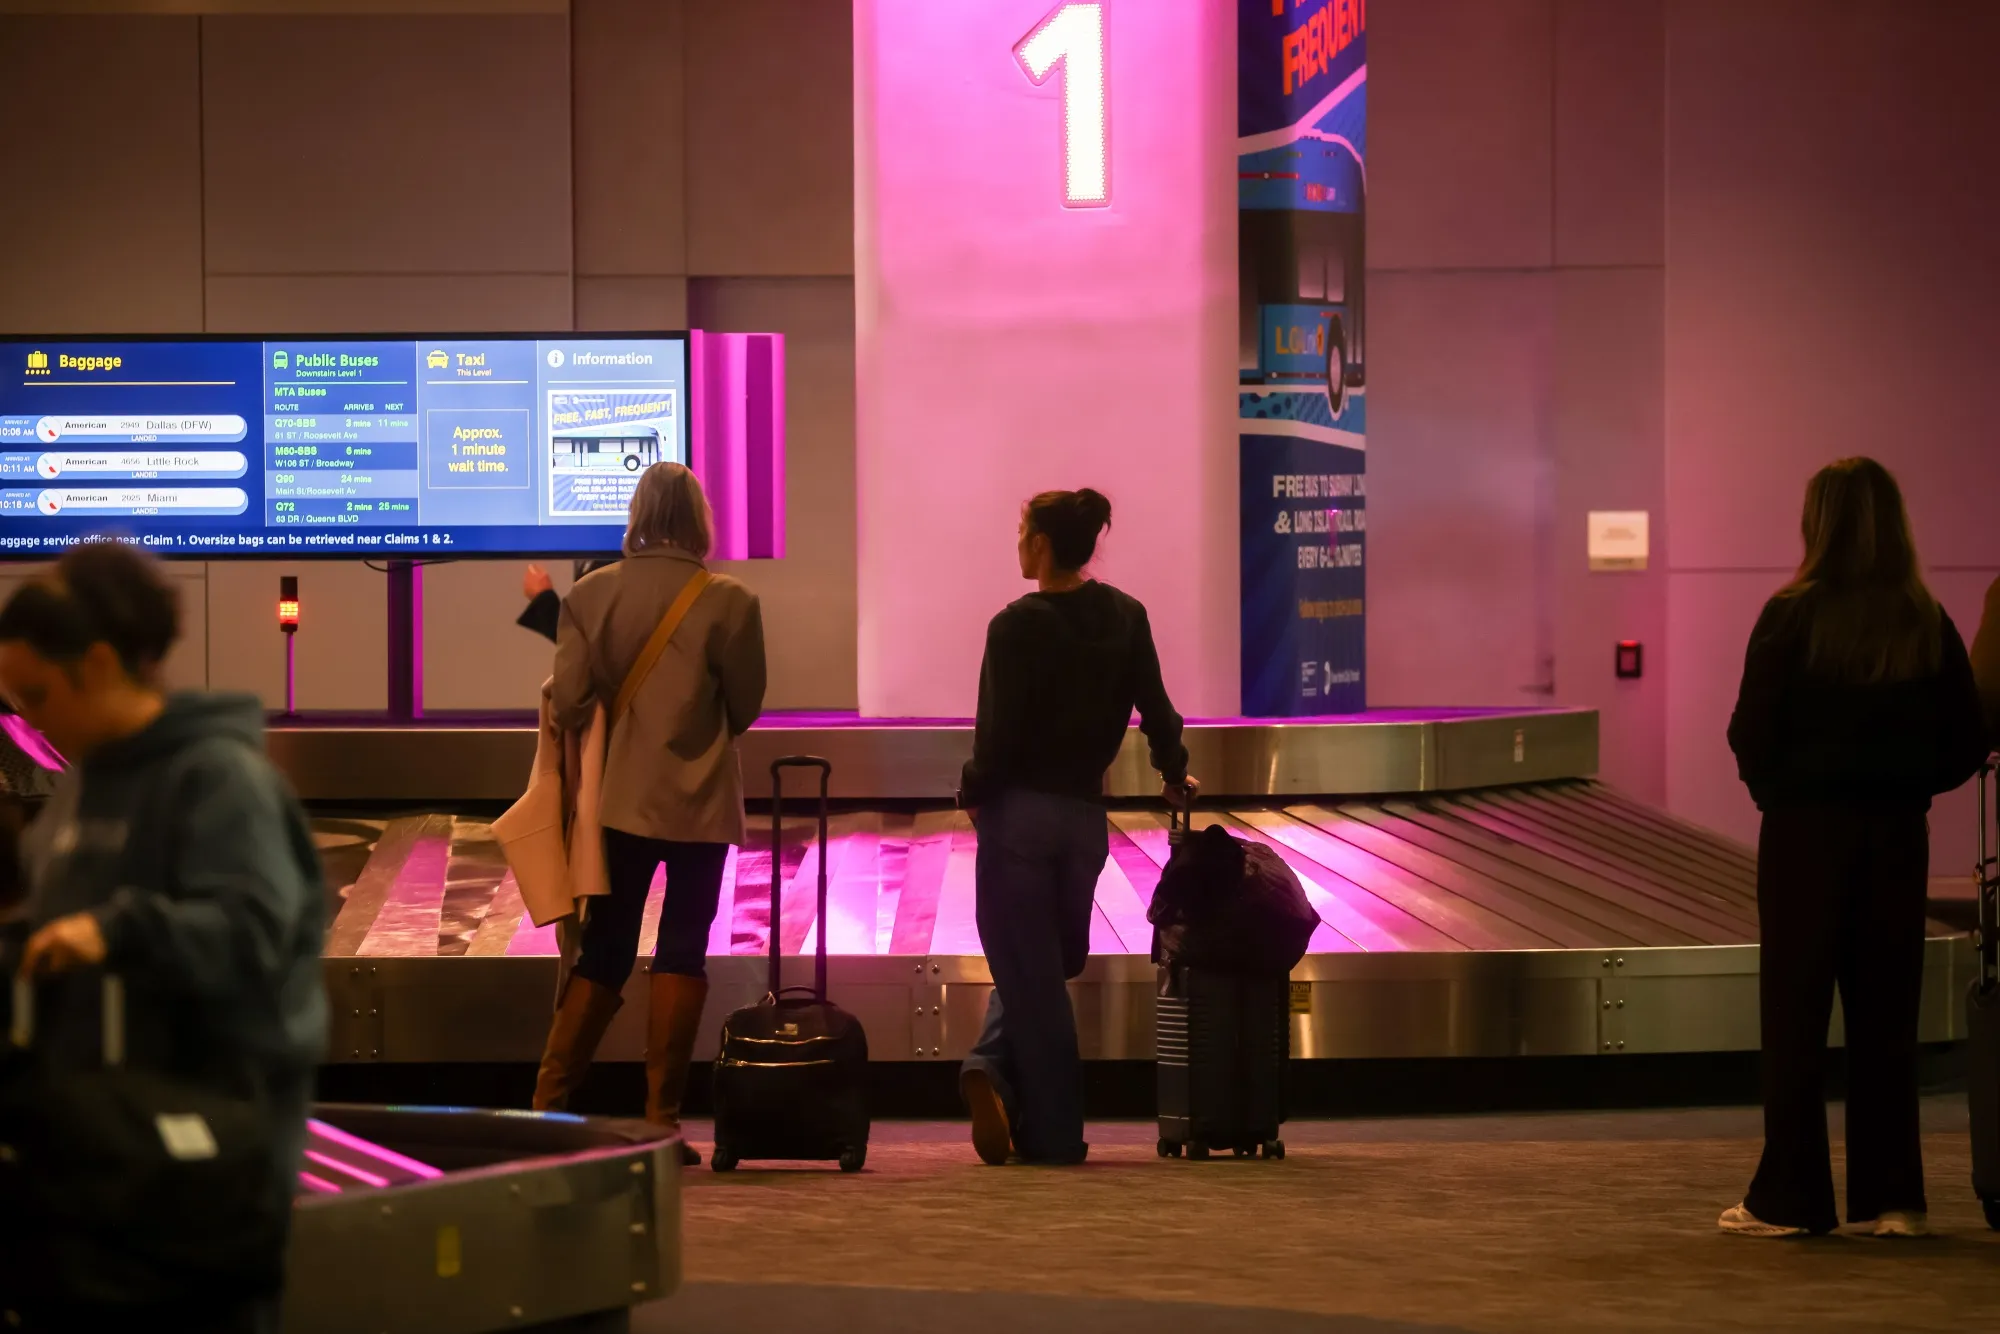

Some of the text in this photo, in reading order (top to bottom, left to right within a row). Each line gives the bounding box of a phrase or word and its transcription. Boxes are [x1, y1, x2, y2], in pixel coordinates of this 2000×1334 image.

[1014, 1, 1110, 207] 1
[59, 354, 122, 371] Baggage
[296, 354, 379, 367] Public Buses
[456, 353, 485, 366] Taxi
[573, 352, 653, 365] Information
[457, 369, 492, 377] This Level
[274, 388, 326, 396] MTA Buses
[146, 421, 177, 430] Dallas
[181, 420, 212, 431] (DFW)
[378, 419, 388, 427] 11
[453, 427, 502, 440] Approx.
[354, 447, 372, 455] mins
[452, 444, 506, 456] 1 minute
[147, 457, 172, 466] Little
[174, 457, 199, 466] Rock
[316, 459, 354, 468] Broadway
[448, 460, 509, 473] wait time.
[354, 475, 372, 483] mins
[66, 494, 108, 502] American
[148, 494, 178, 502] Miami
[276, 502, 295, 512] Q72
[347, 502, 353, 511] 2
[354, 503, 372, 511] mins
[288, 515, 299, 523] DR
[306, 515, 336, 523] Queens
[338, 515, 359, 523] BLVD
[1274, 510, 1291, 534] &
[43, 535, 80, 545] service
[83, 535, 112, 545] office
[116, 537, 140, 545] near
[144, 535, 172, 545] Claim
[177, 535, 186, 545] 1.
[189, 534, 235, 545] Oversize
[239, 534, 264, 547] bags
[267, 536, 285, 545] can
[289, 534, 302, 545] be
[305, 534, 354, 545] retrieved
[357, 536, 381, 544] near
[385, 534, 419, 544] Claims
[423, 534, 428, 544] 1
[432, 534, 441, 544] &
[444, 534, 454, 544] 2.
